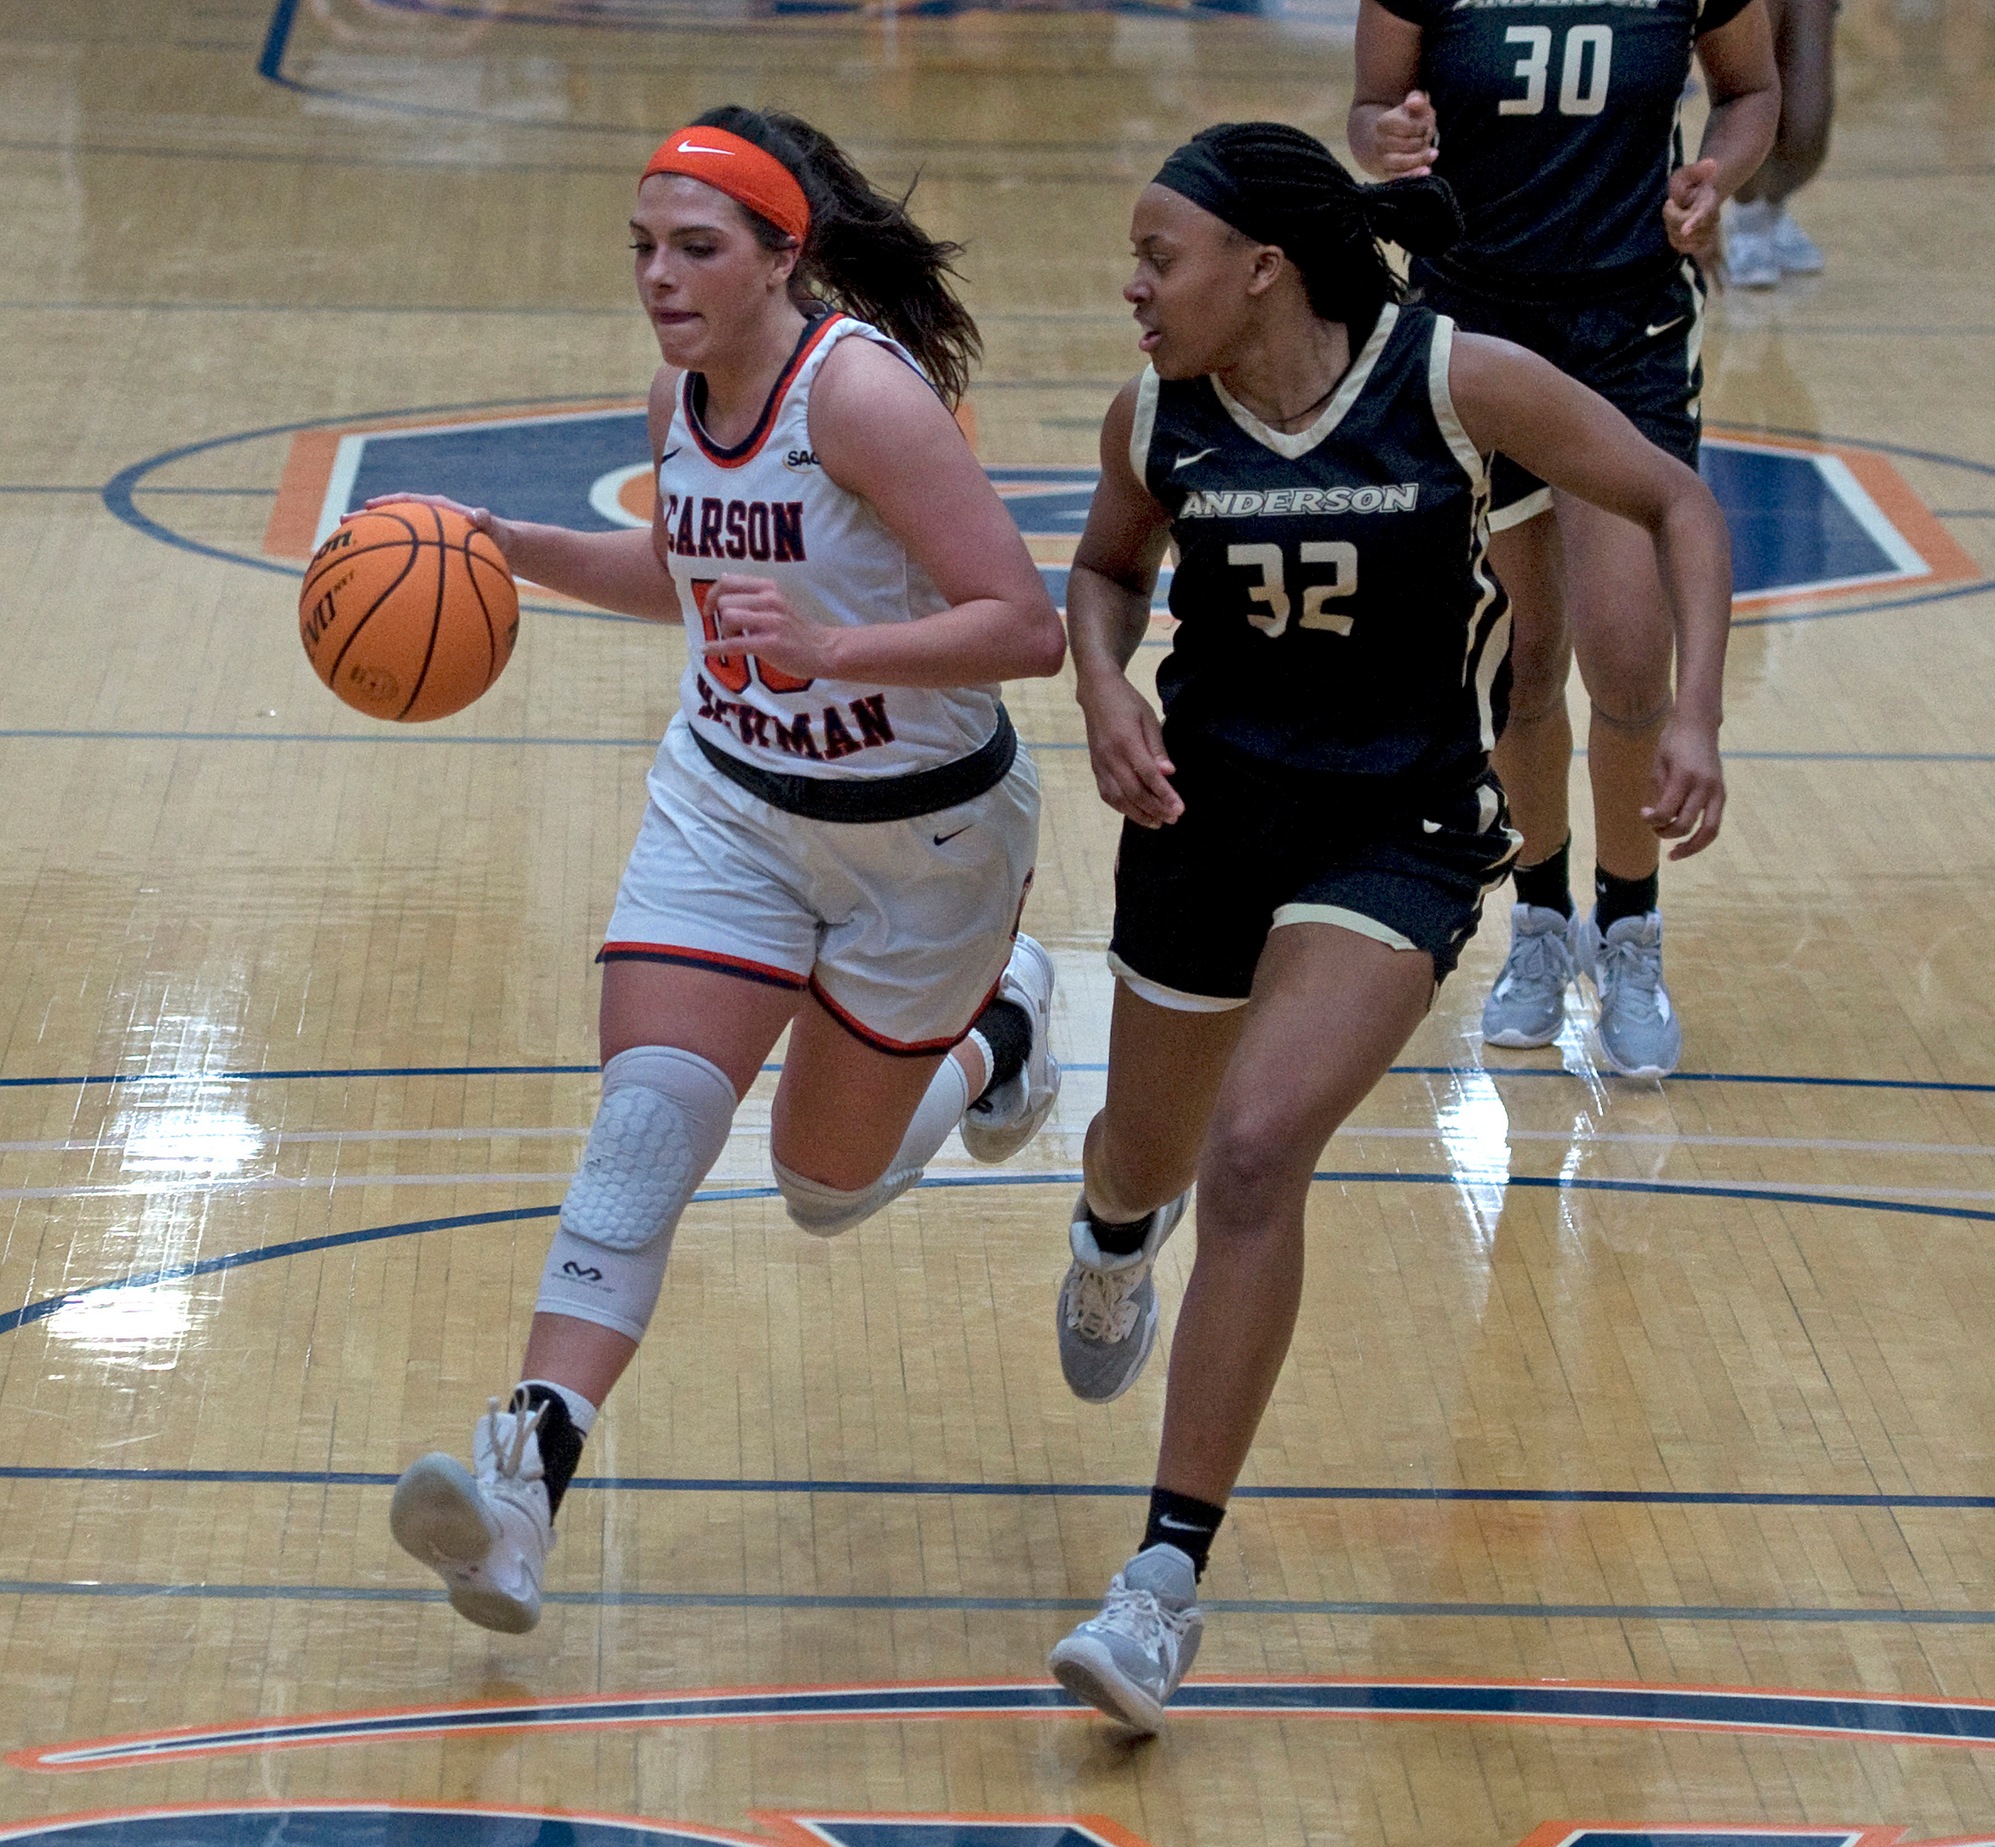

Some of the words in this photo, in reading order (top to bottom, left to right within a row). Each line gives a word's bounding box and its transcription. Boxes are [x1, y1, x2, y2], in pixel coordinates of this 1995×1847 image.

[1498, 24, 1613, 116] 30
[1178, 482, 1419, 519] ANDERSON
[1227, 541, 1358, 638] 32
